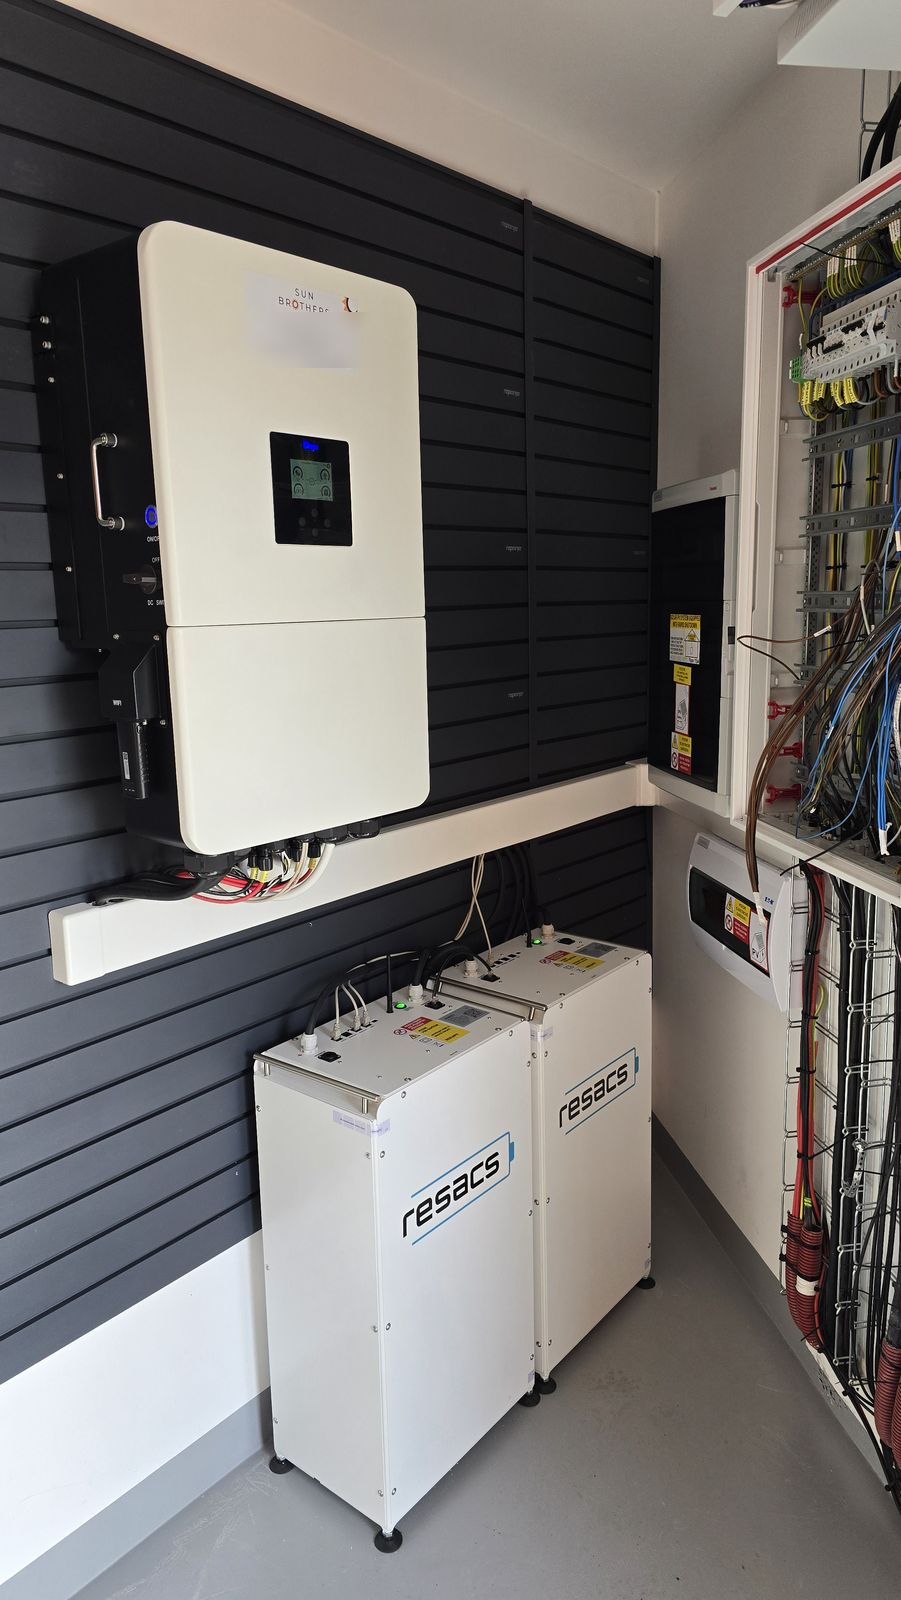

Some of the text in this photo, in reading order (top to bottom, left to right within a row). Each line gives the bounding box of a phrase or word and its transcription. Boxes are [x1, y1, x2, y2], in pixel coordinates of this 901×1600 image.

[294, 287, 315, 301] SUN
[558, 1063, 628, 1129] resacs
[402, 1151, 500, 1239] resacs
